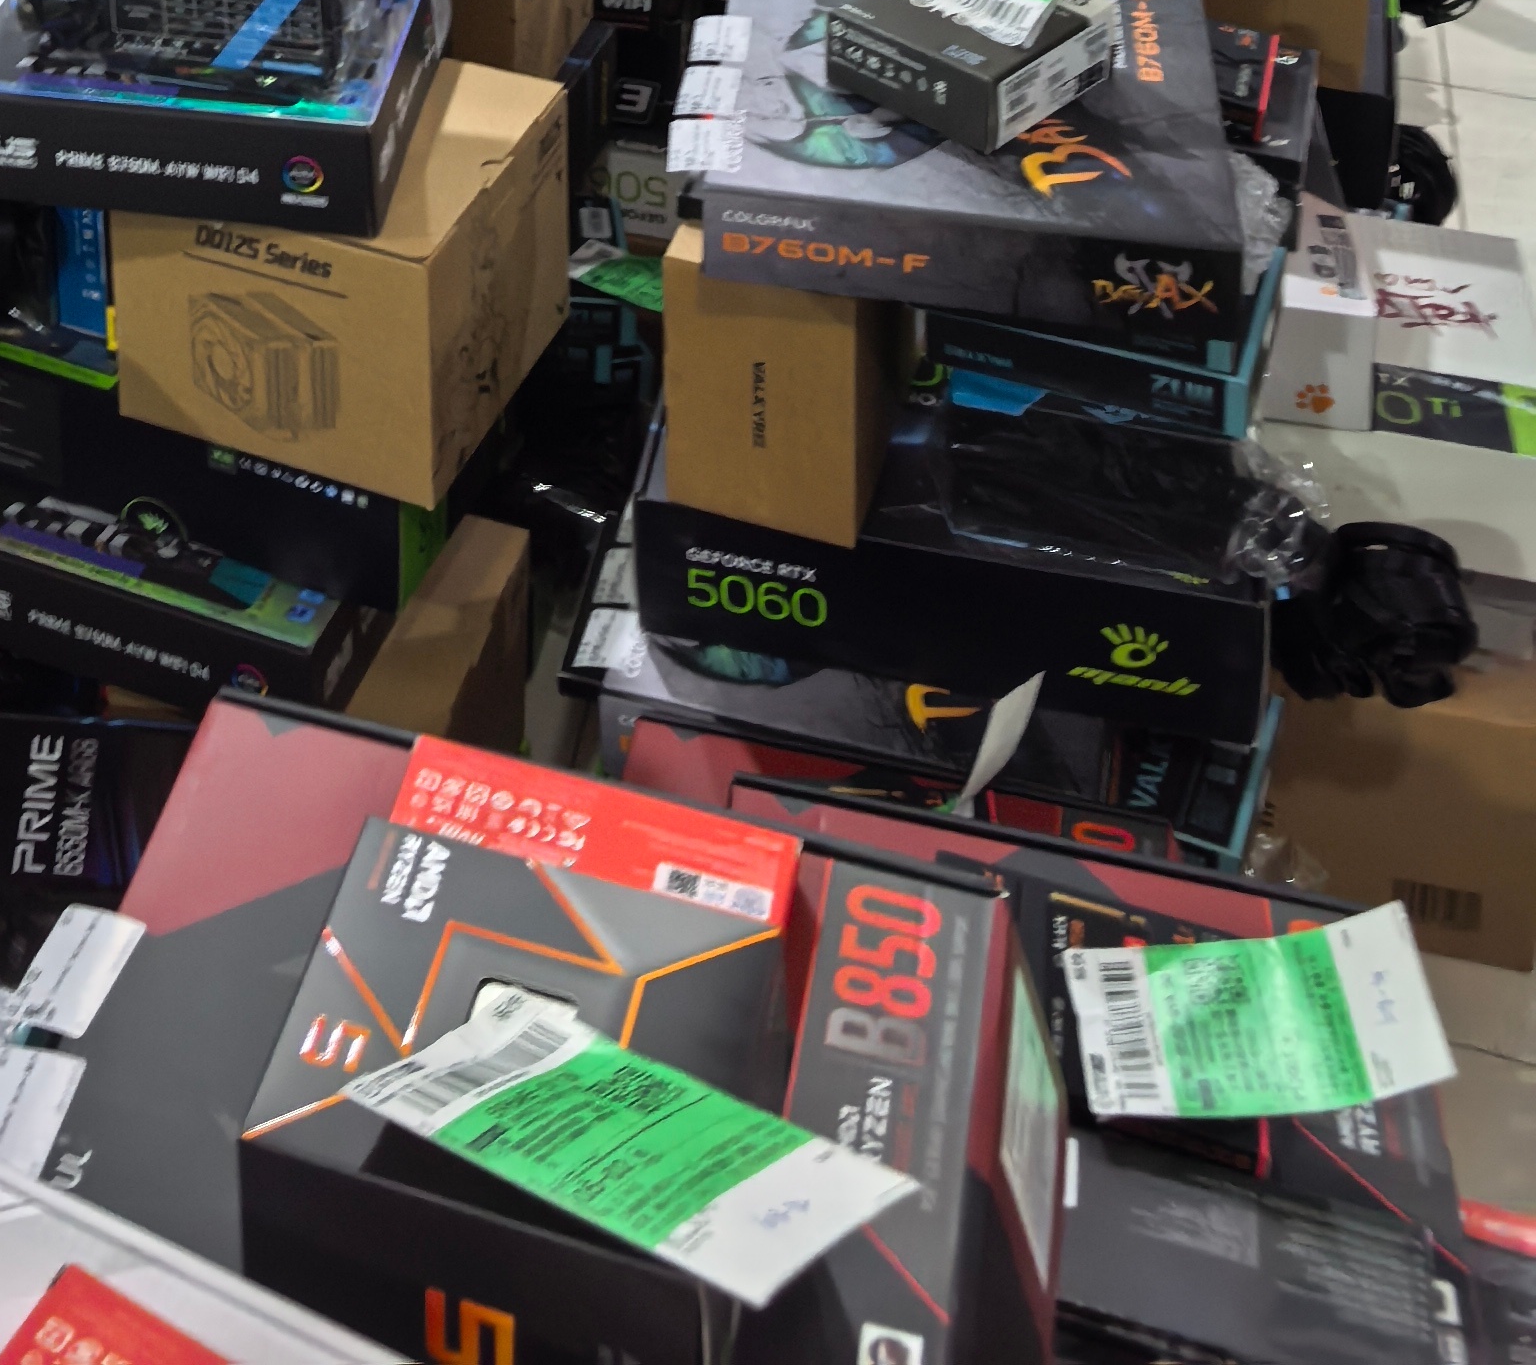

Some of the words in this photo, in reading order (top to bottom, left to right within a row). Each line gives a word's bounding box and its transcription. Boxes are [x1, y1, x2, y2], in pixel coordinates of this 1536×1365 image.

[263, 243, 334, 280] Series
[721, 232, 932, 275] B760M-F
[684, 546, 774, 577] GEFORCE
[776, 556, 818, 584] RTX
[686, 568, 828, 628] 5060
[11, 734, 65, 876] PRIME
[825, 885, 943, 1067] B850
